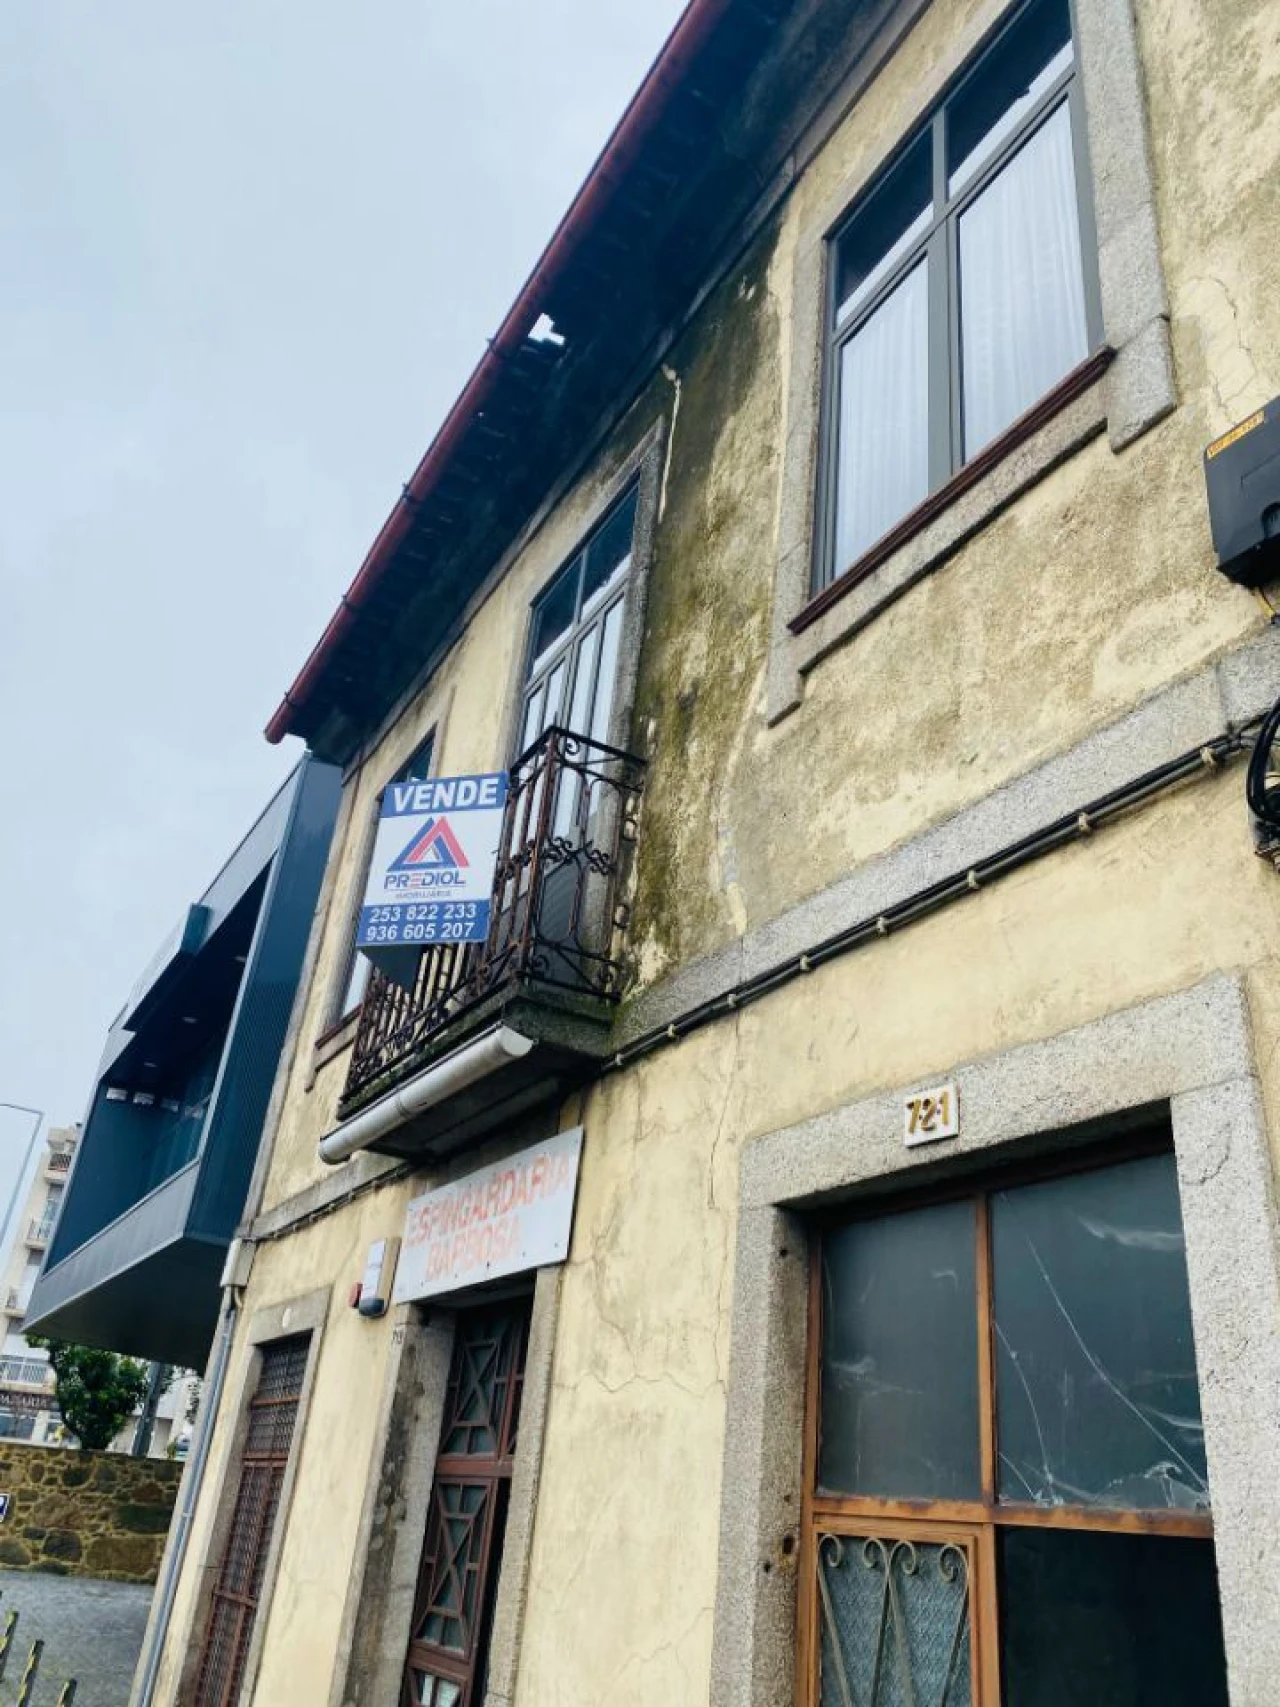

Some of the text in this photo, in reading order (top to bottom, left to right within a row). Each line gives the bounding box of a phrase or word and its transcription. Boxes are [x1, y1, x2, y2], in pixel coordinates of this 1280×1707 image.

[393, 778, 499, 812] VENDE
[383, 871, 466, 890] PREDIOL
[369, 906, 400, 923] 253
[443, 903, 477, 919] 233
[366, 922, 475, 942] 936 605 207
[906, 1091, 949, 1134] 721
